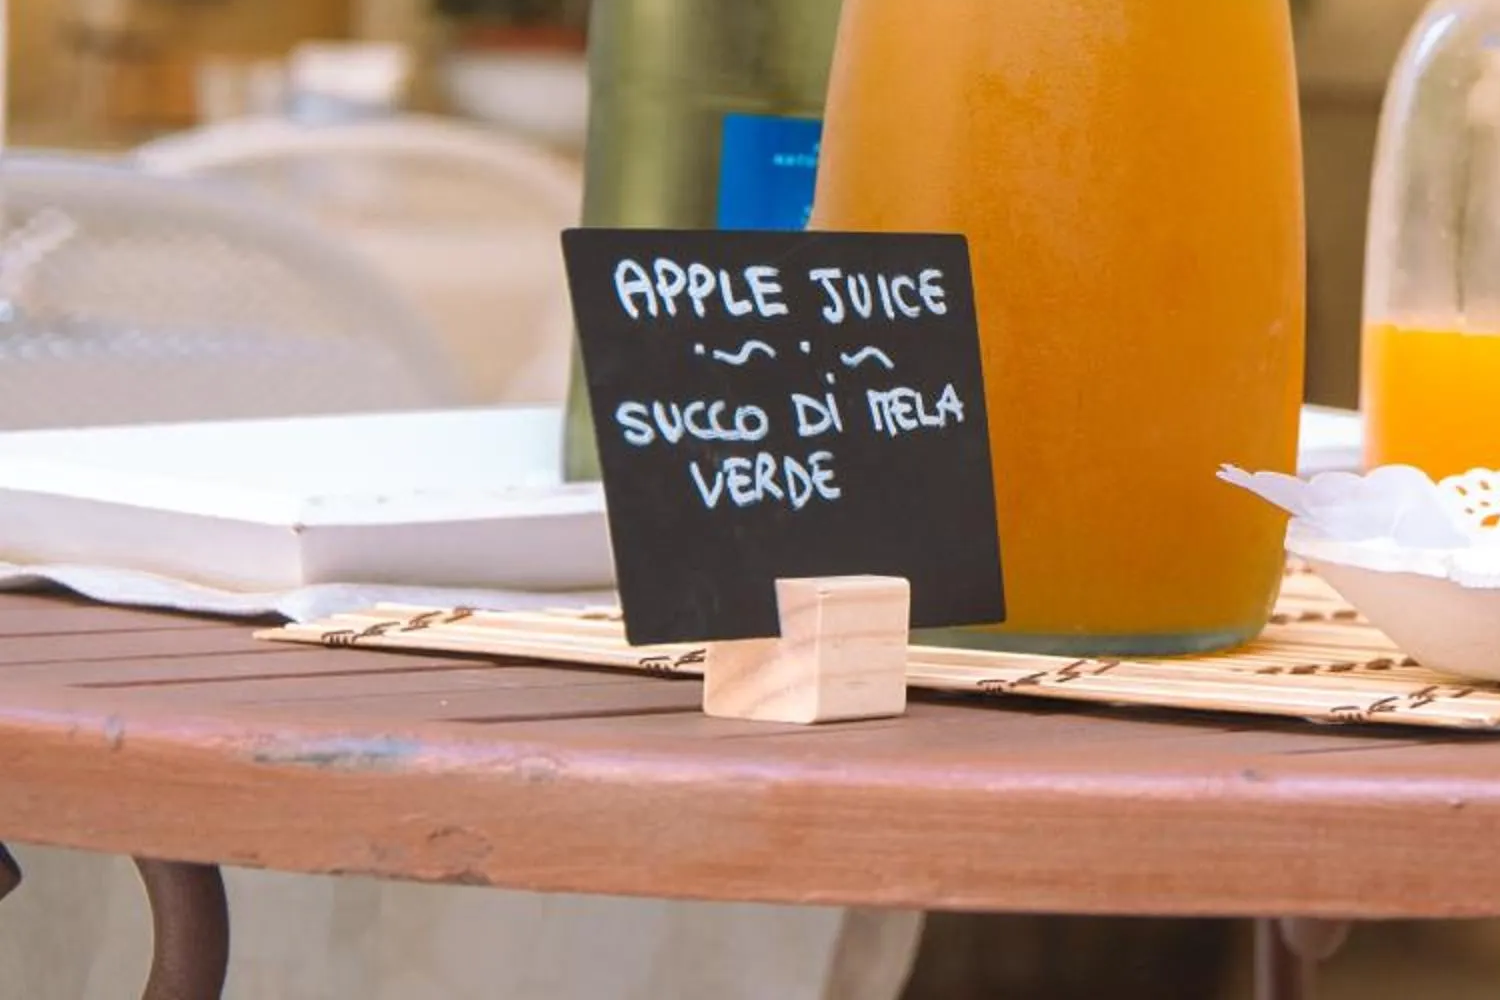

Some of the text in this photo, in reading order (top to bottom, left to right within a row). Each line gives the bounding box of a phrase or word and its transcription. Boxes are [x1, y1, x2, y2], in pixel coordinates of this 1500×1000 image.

[613, 257, 948, 325] APPLE JUICE
[614, 399, 770, 446] SUCCO
[866, 382, 965, 438] MELA
[689, 450, 842, 511] VERDE
